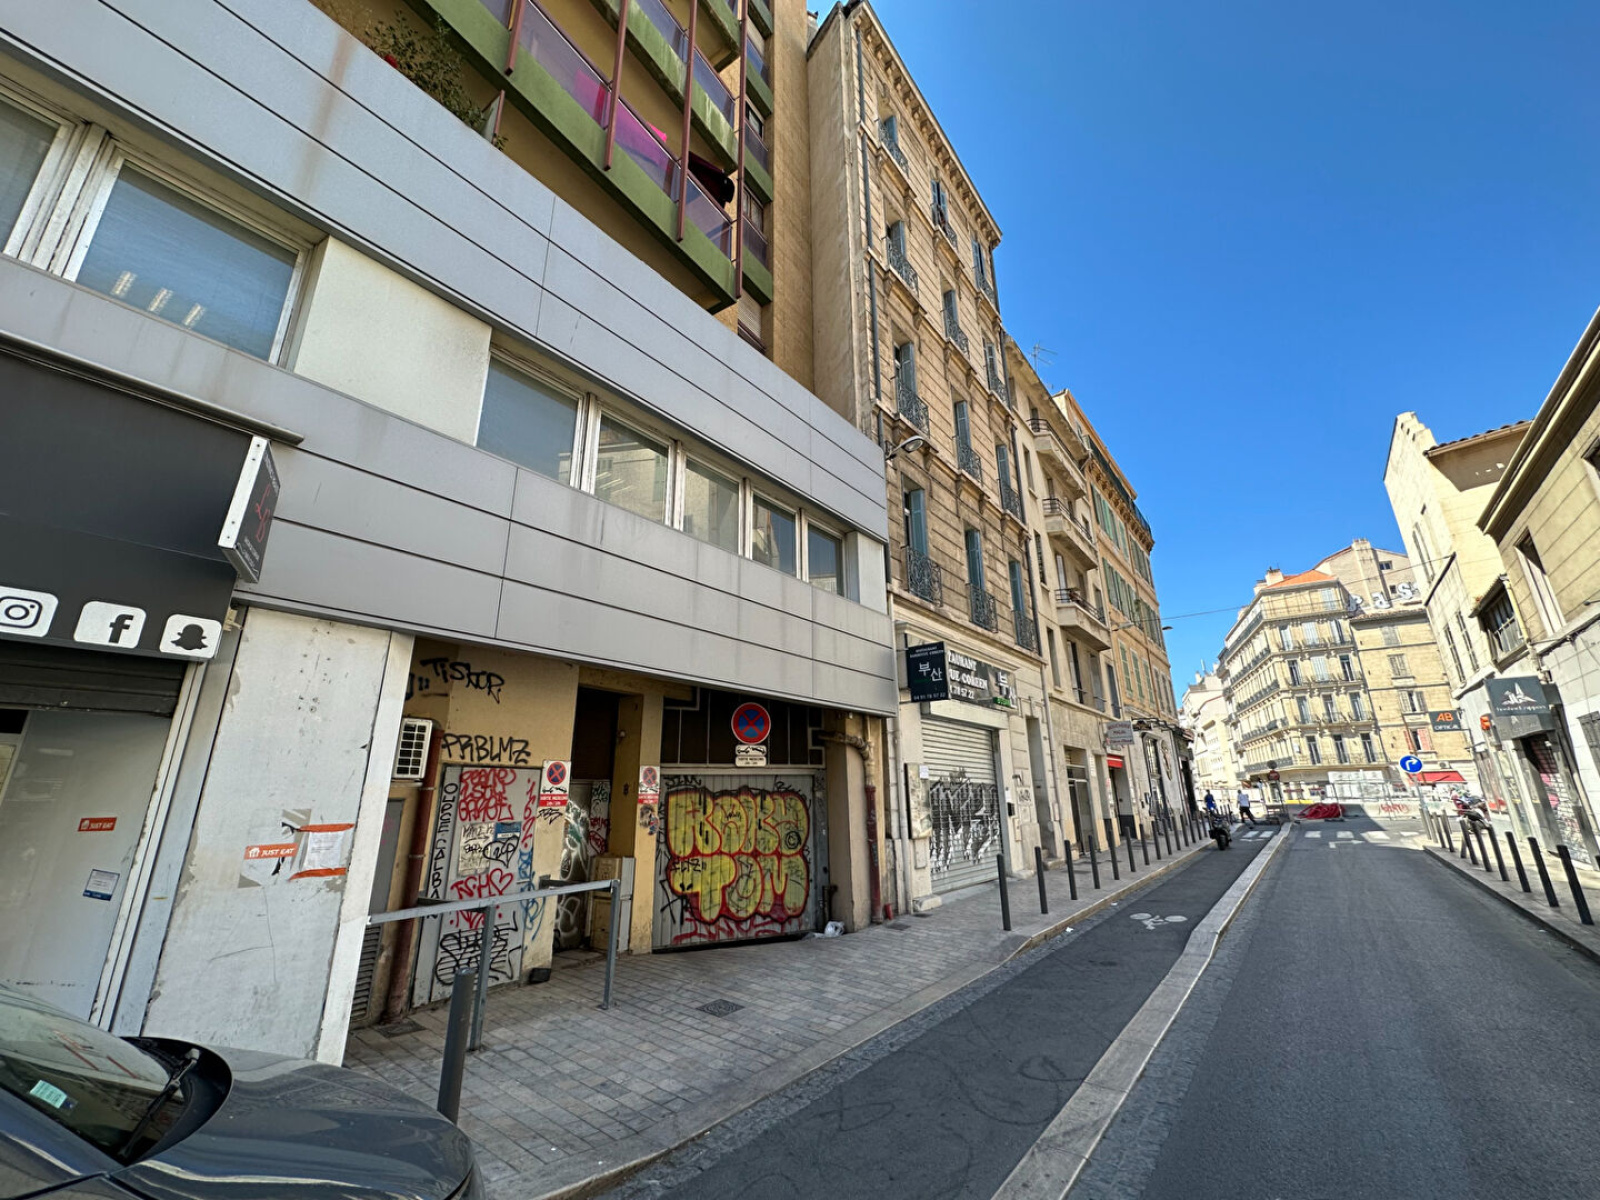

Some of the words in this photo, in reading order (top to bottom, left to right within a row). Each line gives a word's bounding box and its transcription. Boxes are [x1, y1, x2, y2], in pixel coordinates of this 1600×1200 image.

[1436, 712, 1454, 722] AB
[260, 849, 279, 858] JUST
[279, 847, 295, 855] EAT
